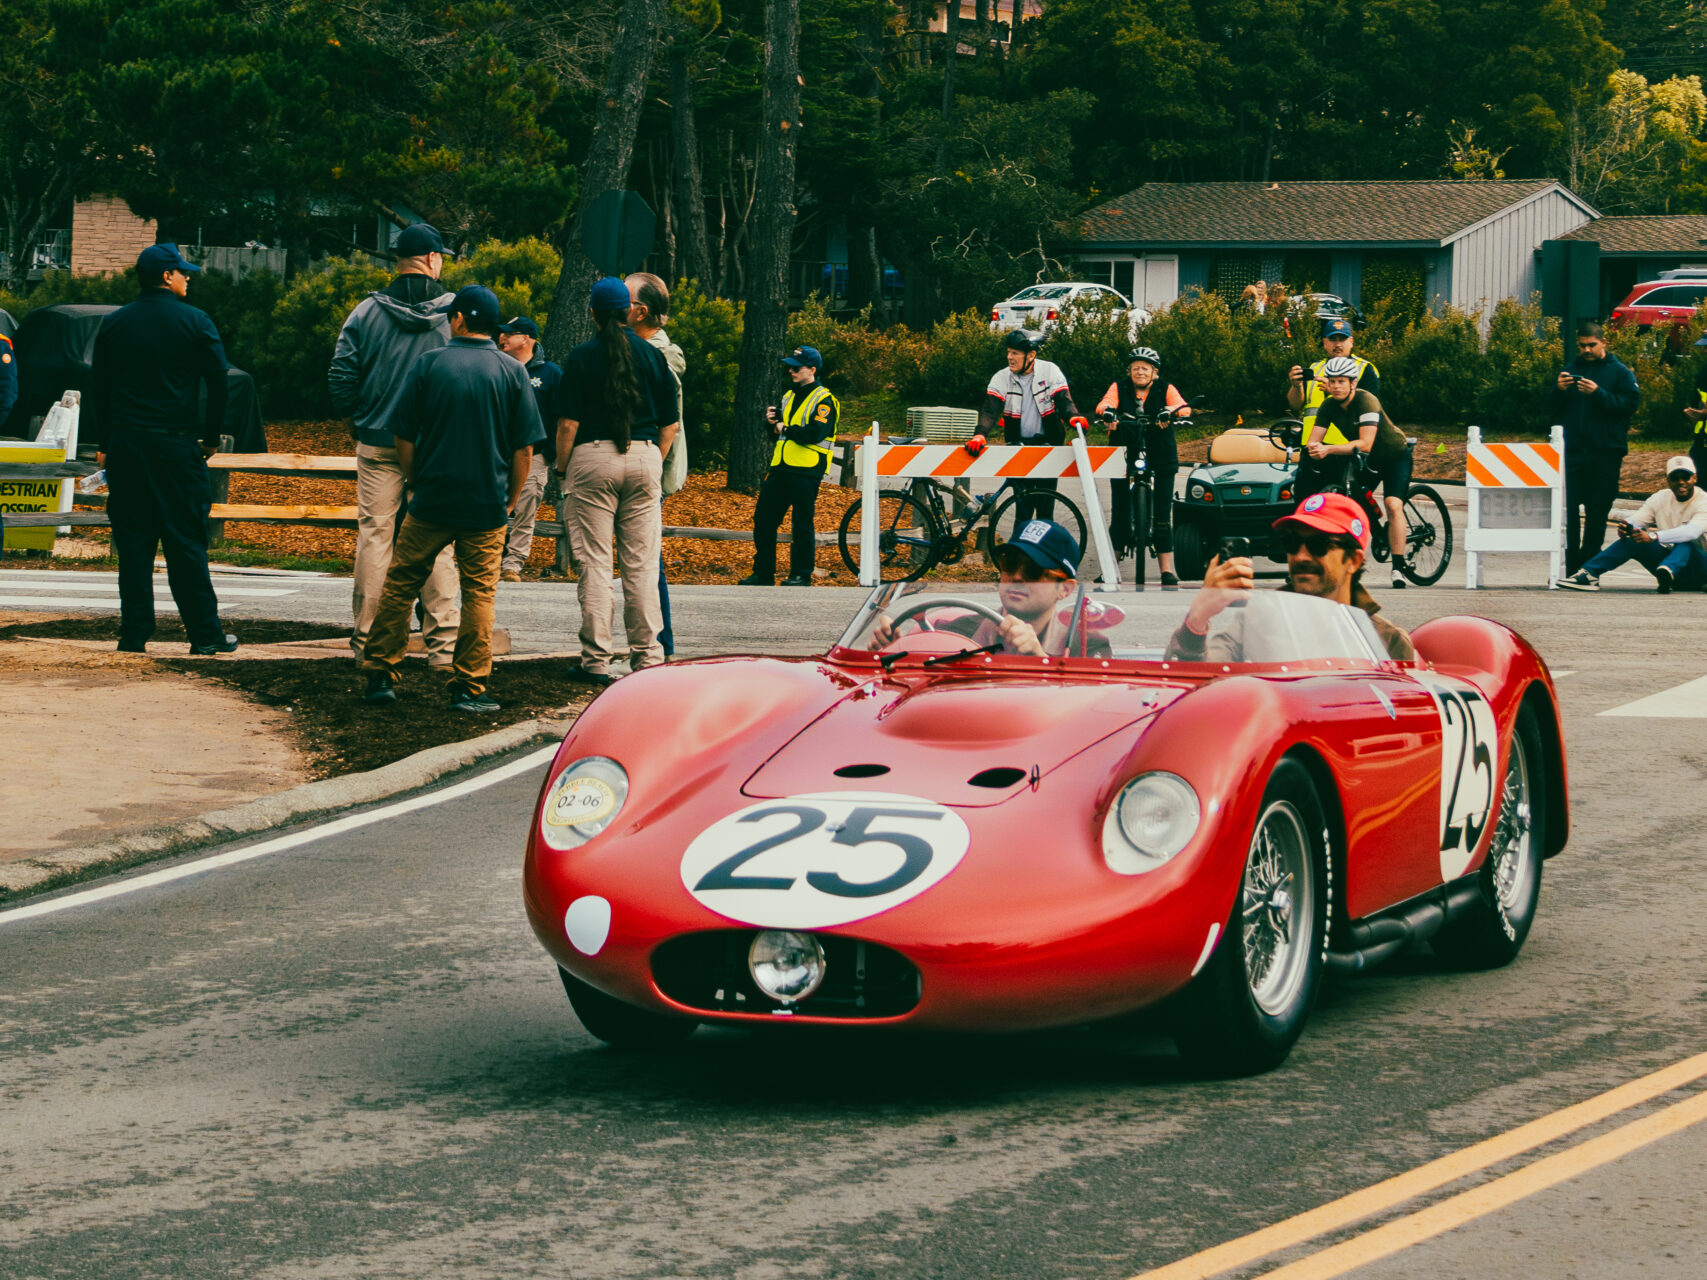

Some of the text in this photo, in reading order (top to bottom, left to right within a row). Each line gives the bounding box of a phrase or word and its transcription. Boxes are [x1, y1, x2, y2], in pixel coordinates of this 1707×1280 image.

[0, 482, 58, 497] ESTRIAN
[1025, 524, 1046, 537] LFG
[1433, 684, 1492, 853] 25
[692, 805, 946, 898] 25
